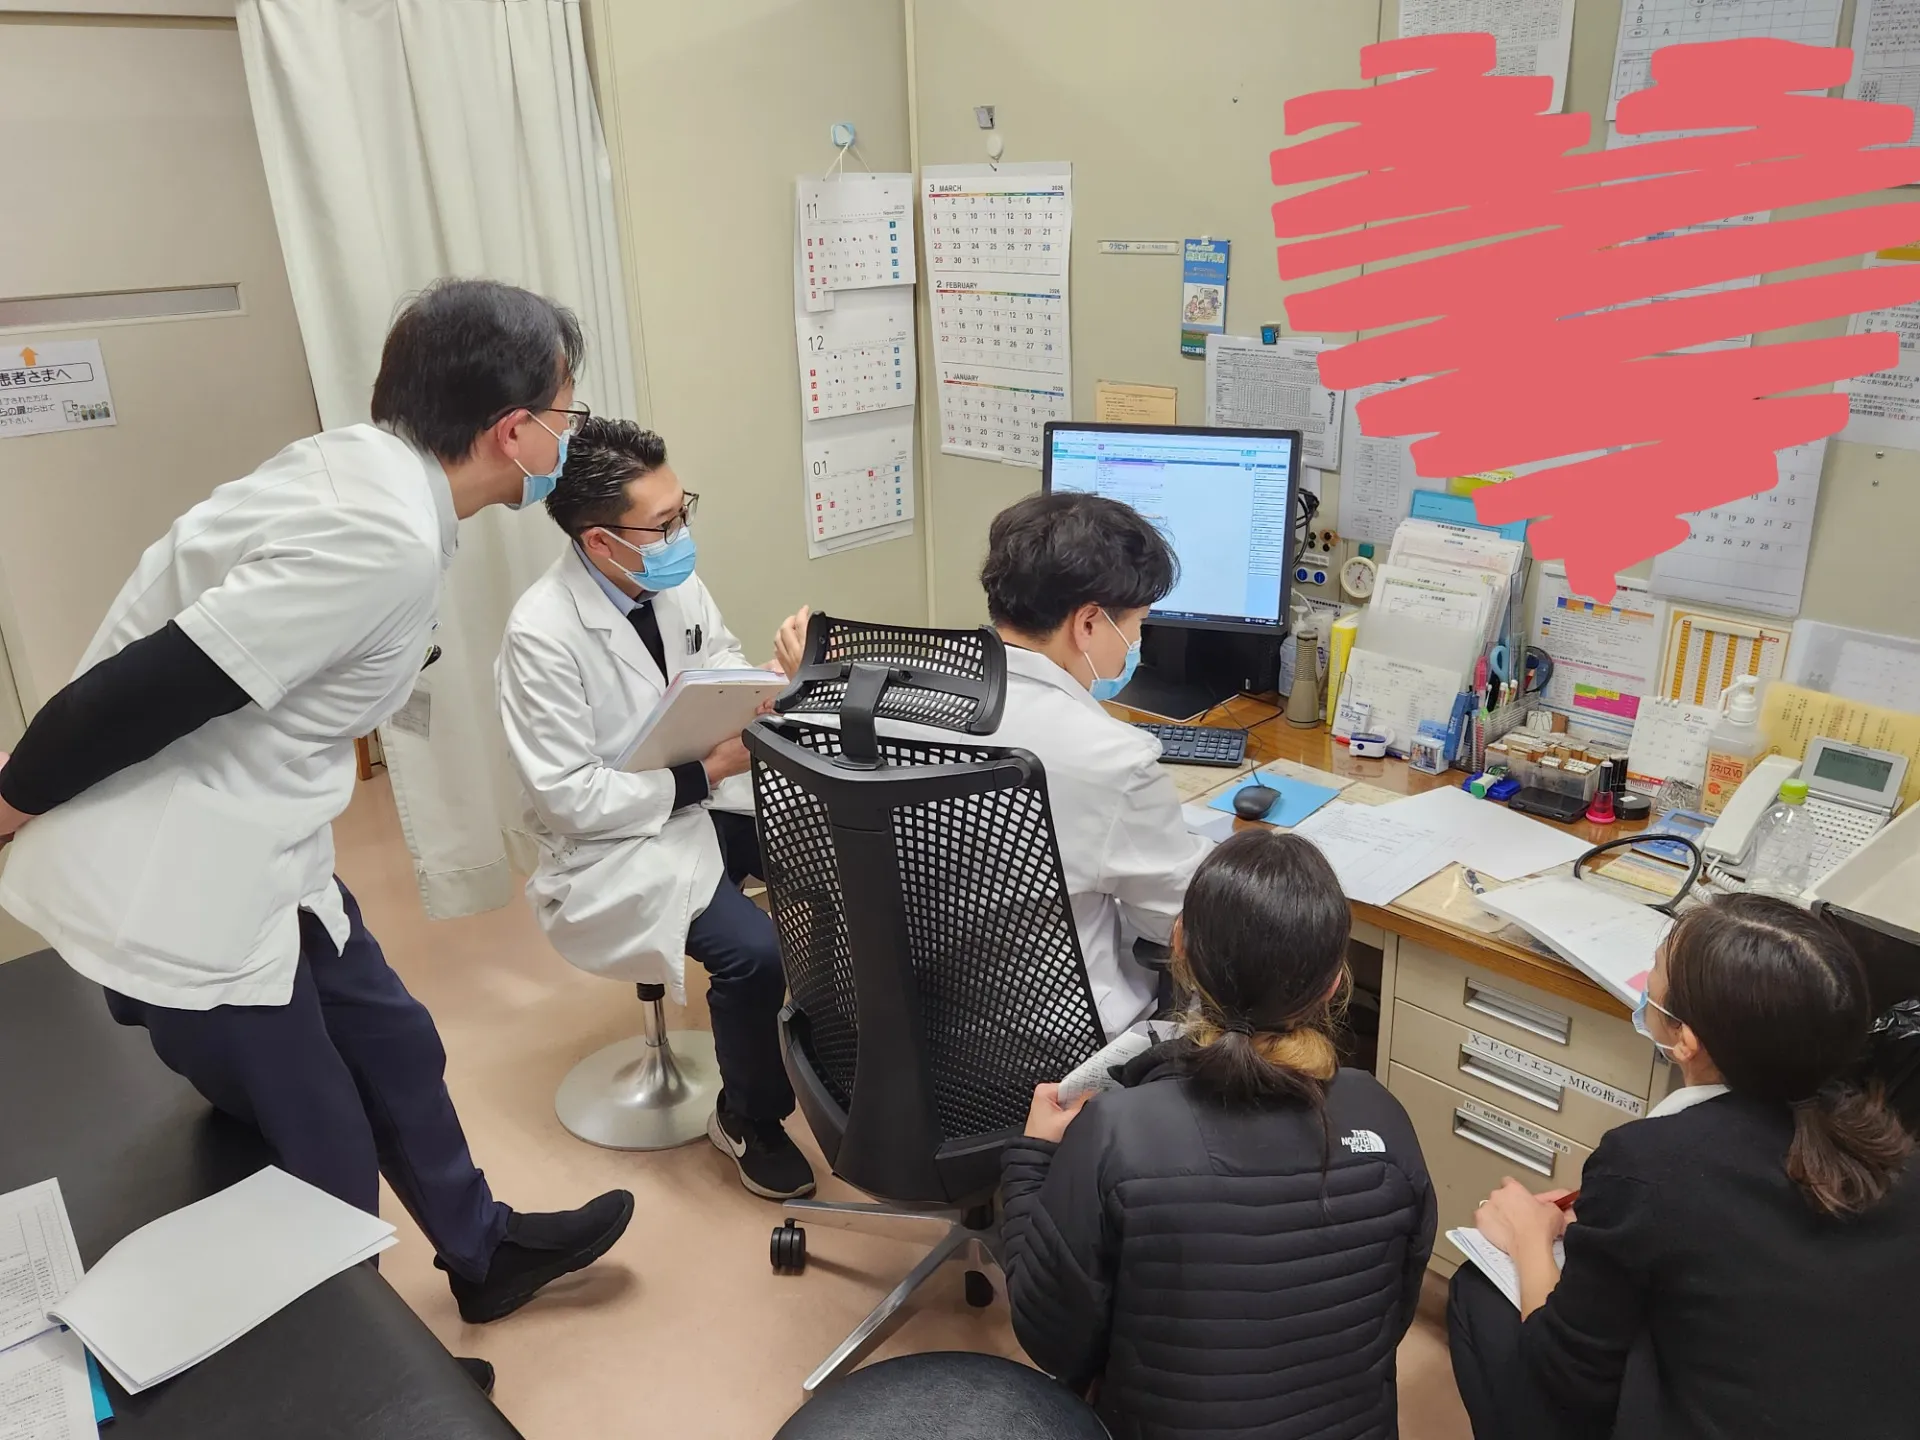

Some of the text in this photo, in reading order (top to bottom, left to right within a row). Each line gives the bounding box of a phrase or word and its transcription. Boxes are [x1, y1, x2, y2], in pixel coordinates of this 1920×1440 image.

[930, 184, 934, 192] 3
[807, 203, 817, 219] 11
[936, 280, 942, 288] 2
[808, 336, 824, 350] 12
[813, 461, 827, 475] 01
[1684, 713, 1691, 721] 2
[1351, 1130, 1368, 1138] THE
[1341, 1136, 1370, 1146] NORTH
[1350, 1144, 1372, 1153] FACE
